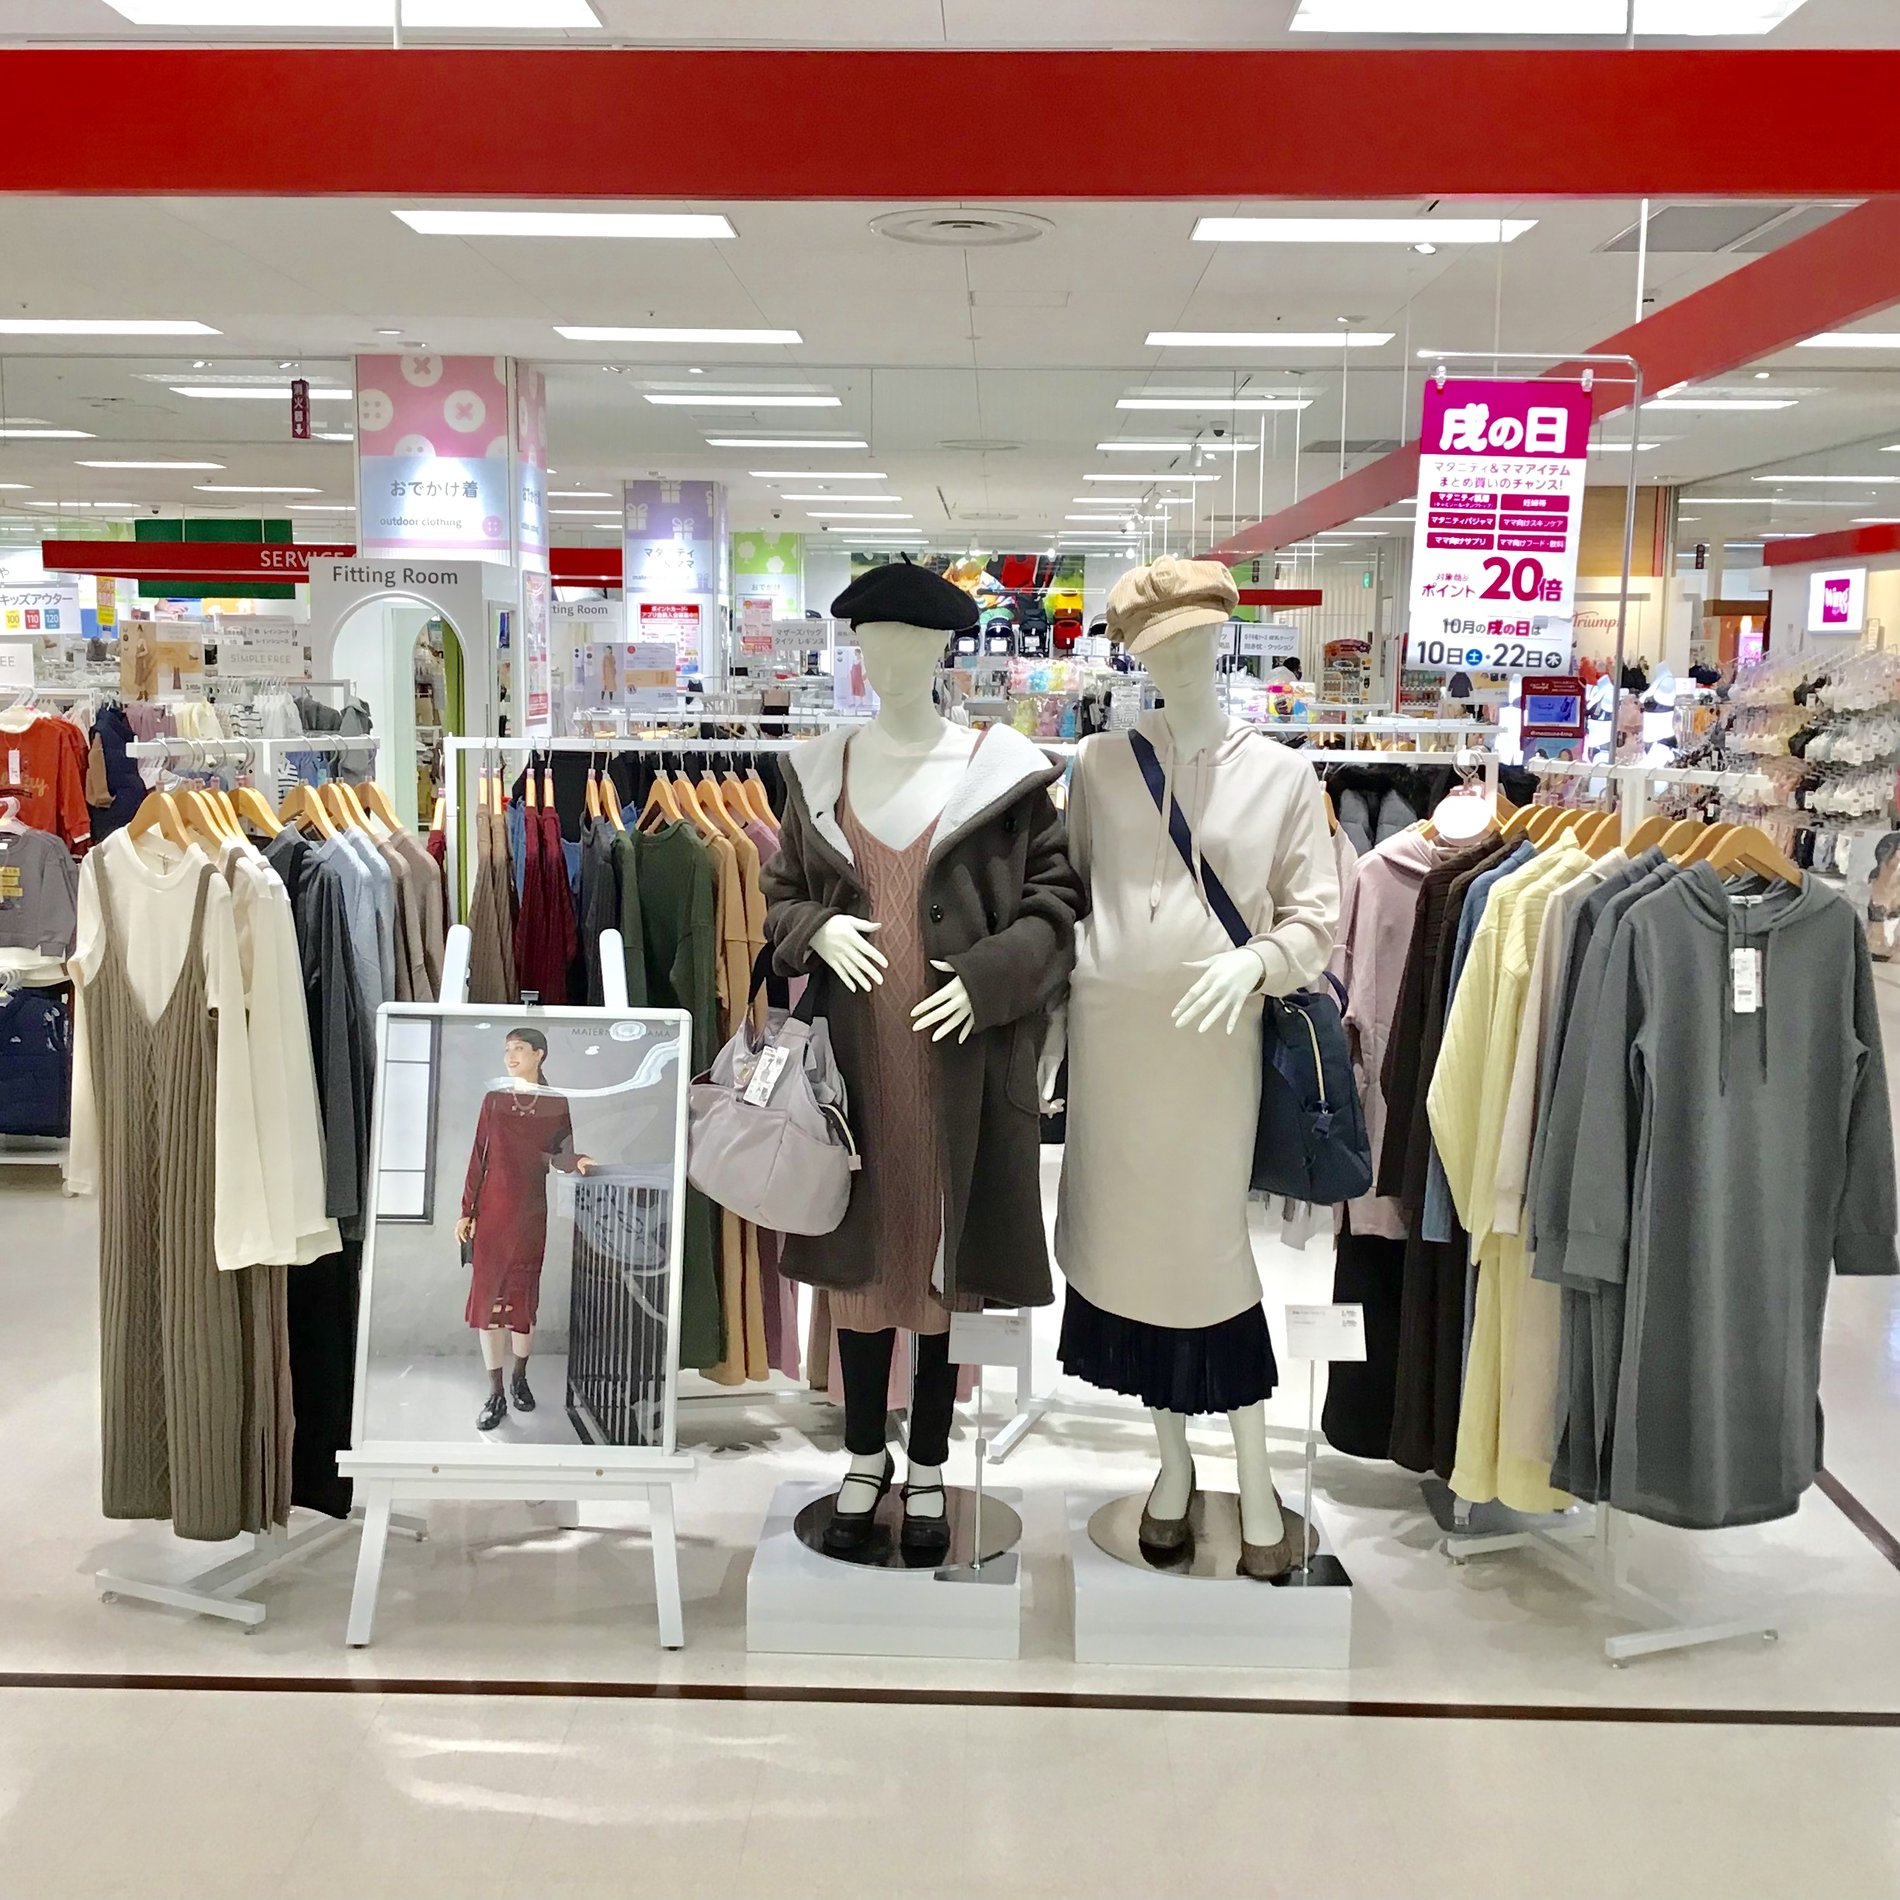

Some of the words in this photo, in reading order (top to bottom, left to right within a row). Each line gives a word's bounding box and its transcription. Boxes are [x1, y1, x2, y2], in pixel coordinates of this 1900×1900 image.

[1439, 402, 1569, 454] 戌の日
[1434, 462, 1571, 477] マタニティ&ママアイテム
[391, 480, 478, 498] おでかけ着
[1440, 477, 1563, 490] まとめ買いのチャンス!
[380, 517, 419, 526] outdoor
[422, 518, 462, 529] clothing
[1431, 516, 1494, 526] マタニティパジャマ
[1503, 519, 1564, 528] ママ向けスキンケア
[1434, 536, 1487, 546] ママ向けサプリ
[333, 566, 396, 588] Fitting
[403, 568, 458, 585] Room
[0, 592, 73, 606] キッズアウター
[1825, 587, 1849, 614] Wing
[577, 605, 608, 615] Room
[27, 614, 39, 624] 110
[46, 614, 59, 624] 120
[1571, 610, 1619, 634] Triump
[231, 654, 266, 664] SIMPLE
[267, 655, 291, 664] FREE
[572, 1028, 610, 1037] MATERN
